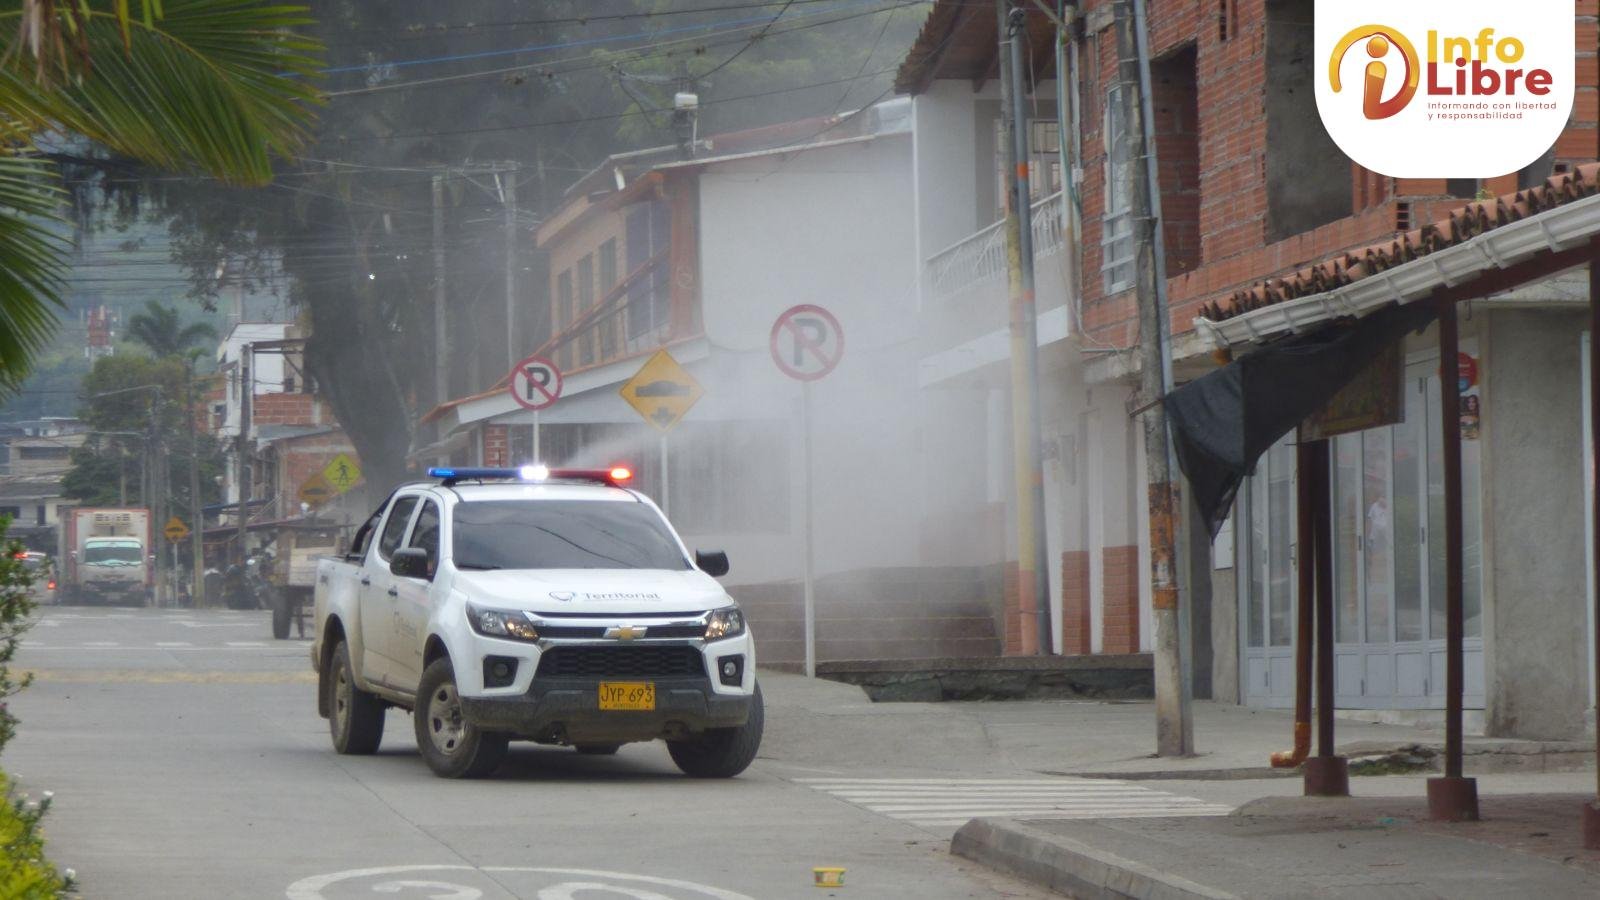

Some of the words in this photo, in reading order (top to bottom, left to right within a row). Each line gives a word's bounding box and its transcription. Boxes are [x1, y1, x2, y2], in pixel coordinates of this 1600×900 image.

[793, 318, 827, 367] P
[526, 366, 551, 400] P
[583, 591, 661, 601] Territorial
[600, 685, 625, 702] JYP
[628, 687, 653, 703] 693
